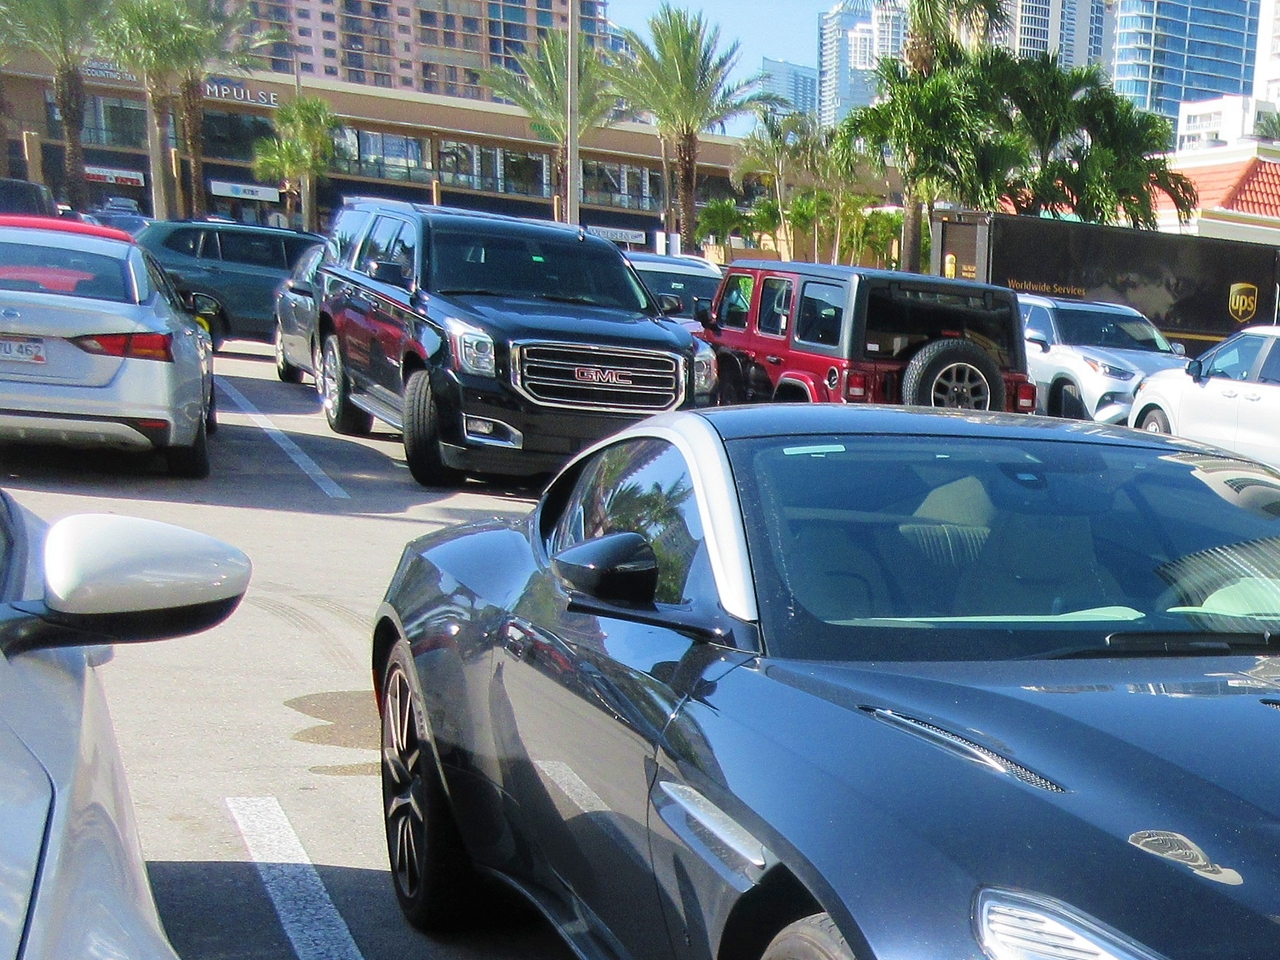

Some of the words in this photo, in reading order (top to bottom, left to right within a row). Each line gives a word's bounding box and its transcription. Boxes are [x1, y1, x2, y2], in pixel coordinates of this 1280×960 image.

[1008, 279, 1051, 293] Worldwide
[1053, 283, 1086, 296] Services
[1231, 294, 1255, 316] ups
[575, 367, 632, 384] GMC
